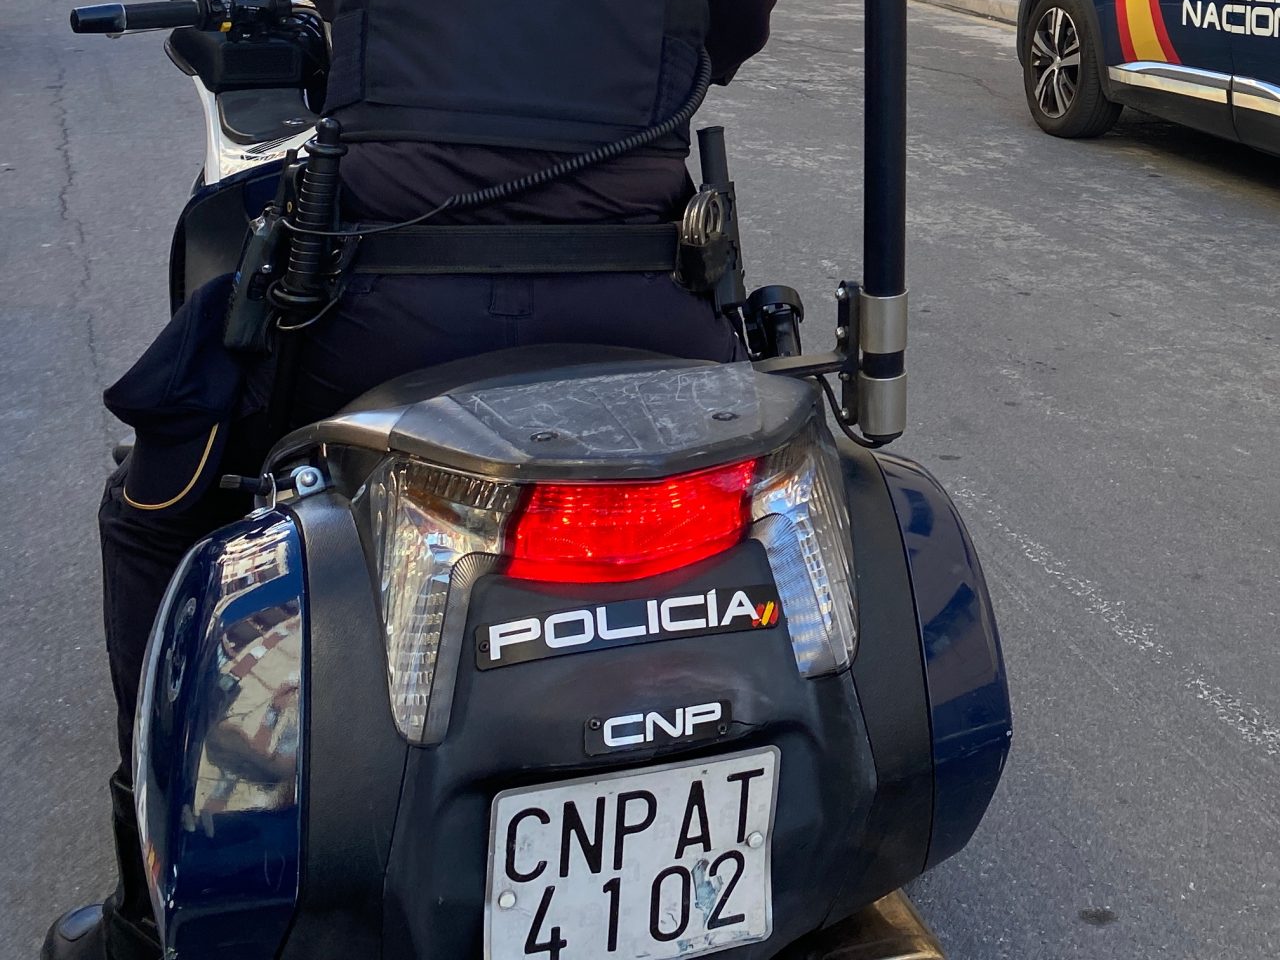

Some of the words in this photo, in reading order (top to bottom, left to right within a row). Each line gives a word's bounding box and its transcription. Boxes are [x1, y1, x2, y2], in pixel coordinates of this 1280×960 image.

[489, 589, 760, 661] POLICÍA
[603, 702, 722, 747] CNP
[524, 849, 746, 960] 4102
